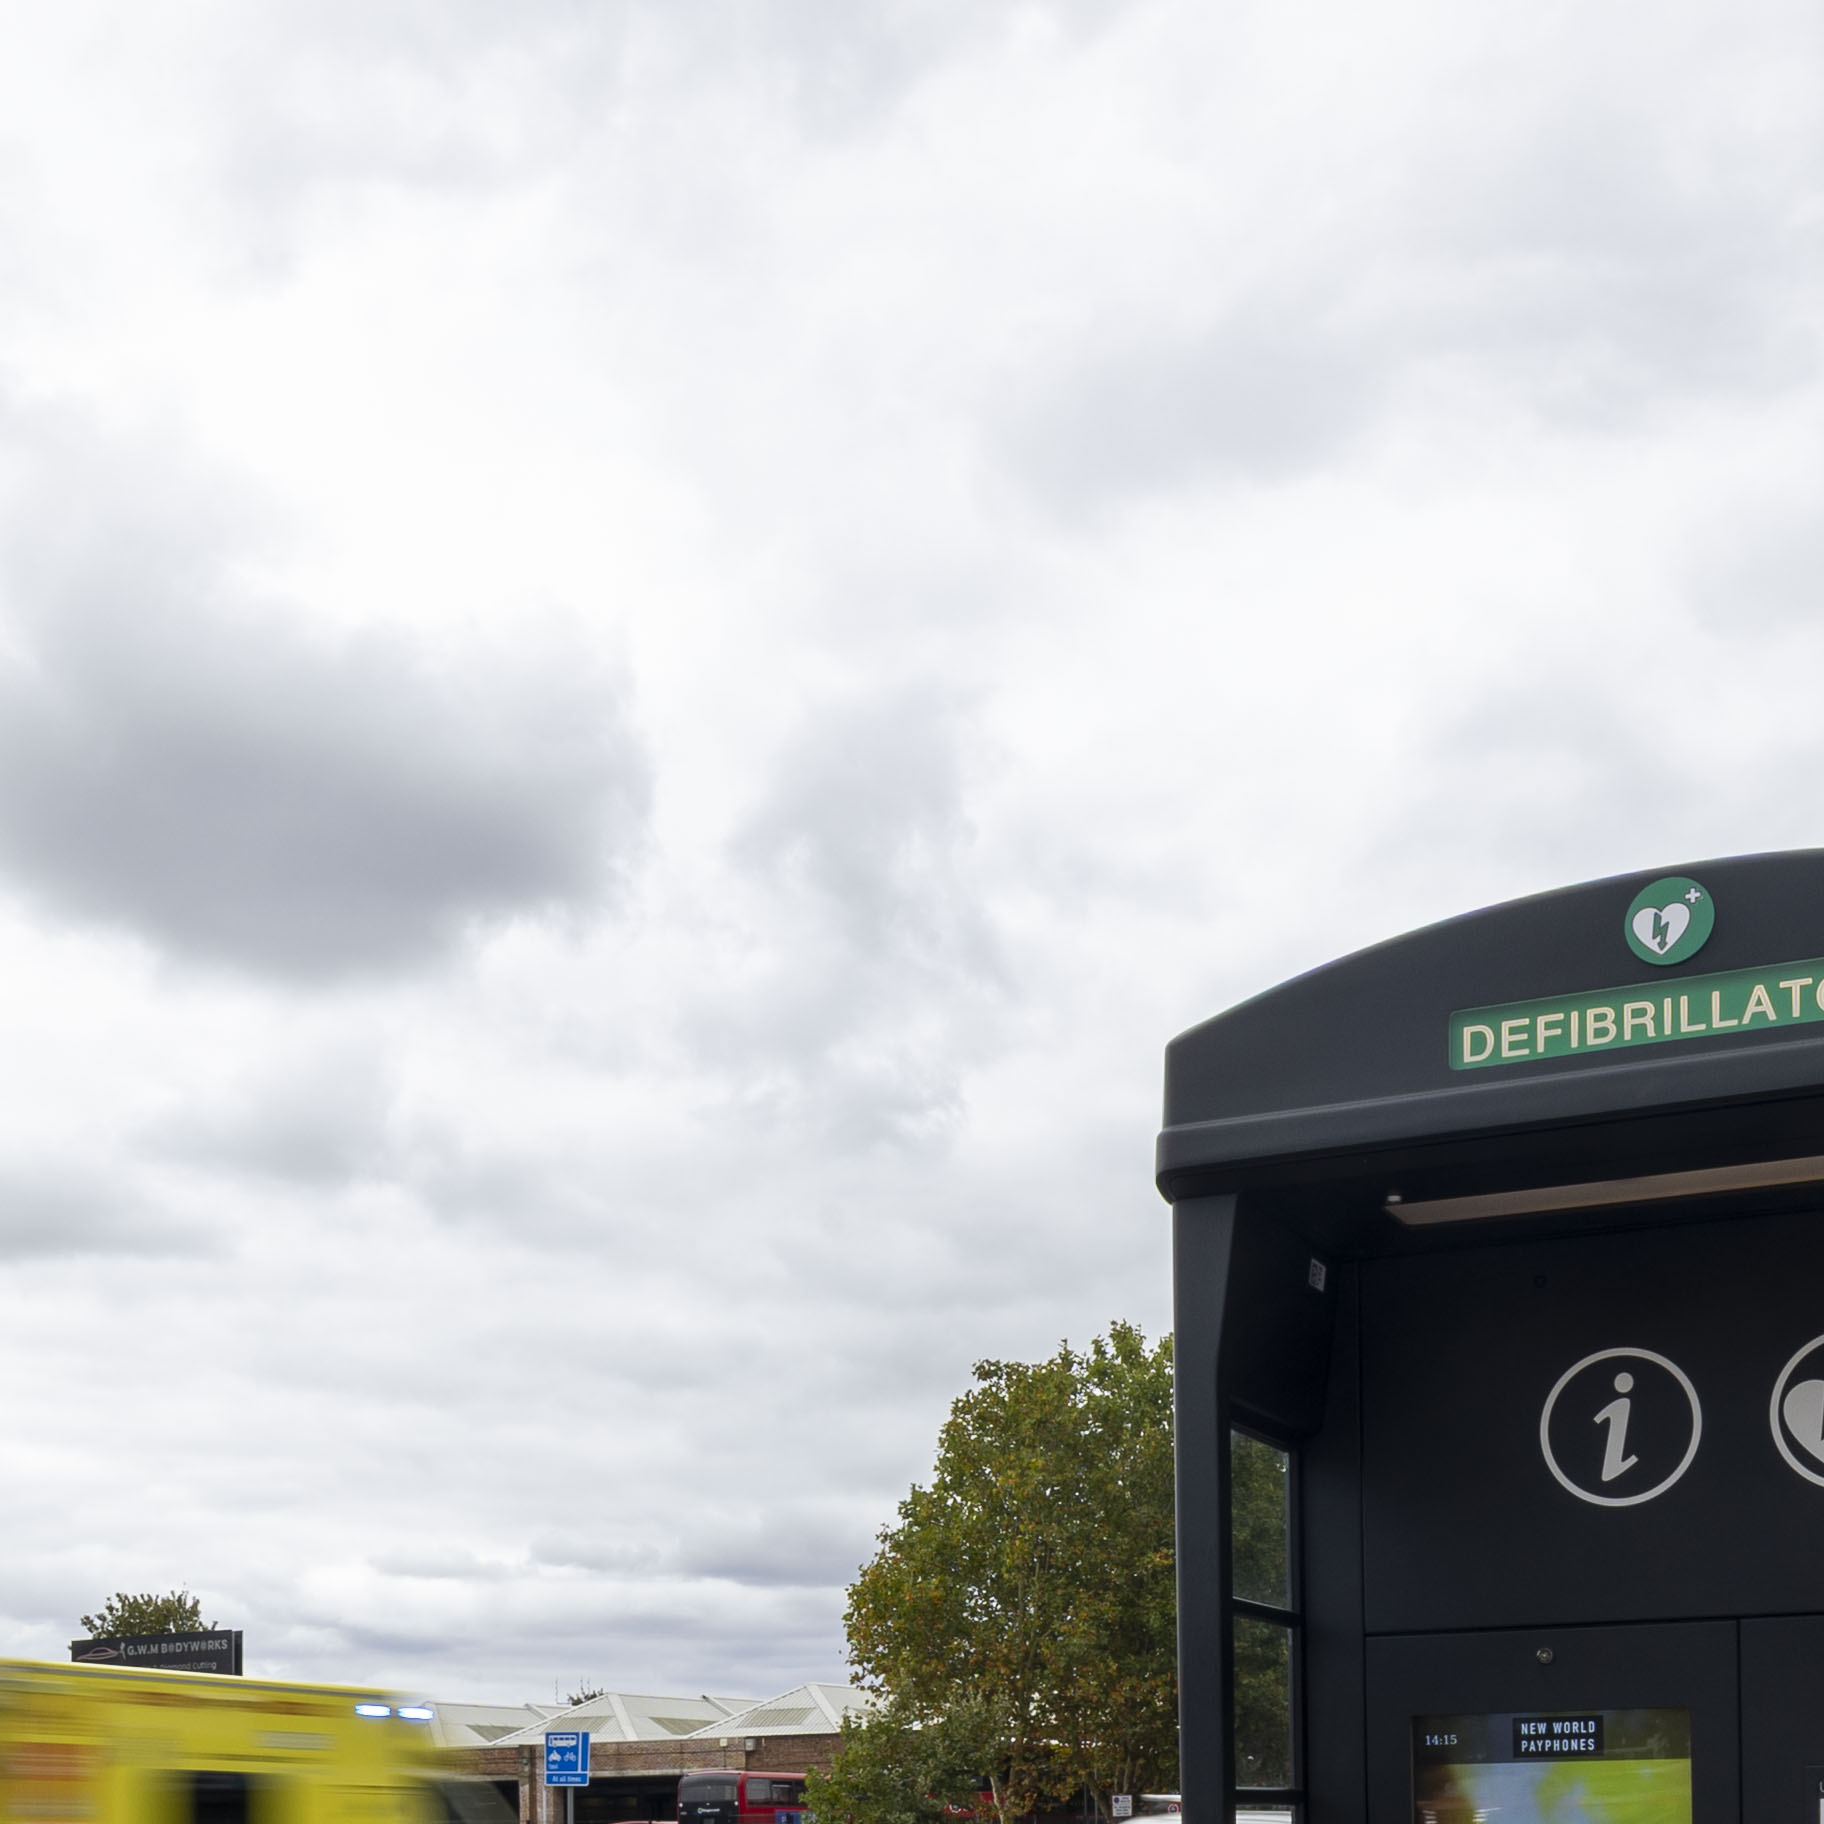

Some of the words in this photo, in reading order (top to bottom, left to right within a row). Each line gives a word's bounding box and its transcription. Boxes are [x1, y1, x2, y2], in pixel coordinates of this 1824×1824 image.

[127, 1643, 159, 1656] G.W.M
[161, 1639, 228, 1654] BODYWORKS
[1425, 1734, 1458, 1746] 14:15
[1521, 1722, 1547, 1735] NEW
[1553, 1720, 1596, 1734] WORLD
[1521, 1738, 1595, 1753] PAYPHONES
